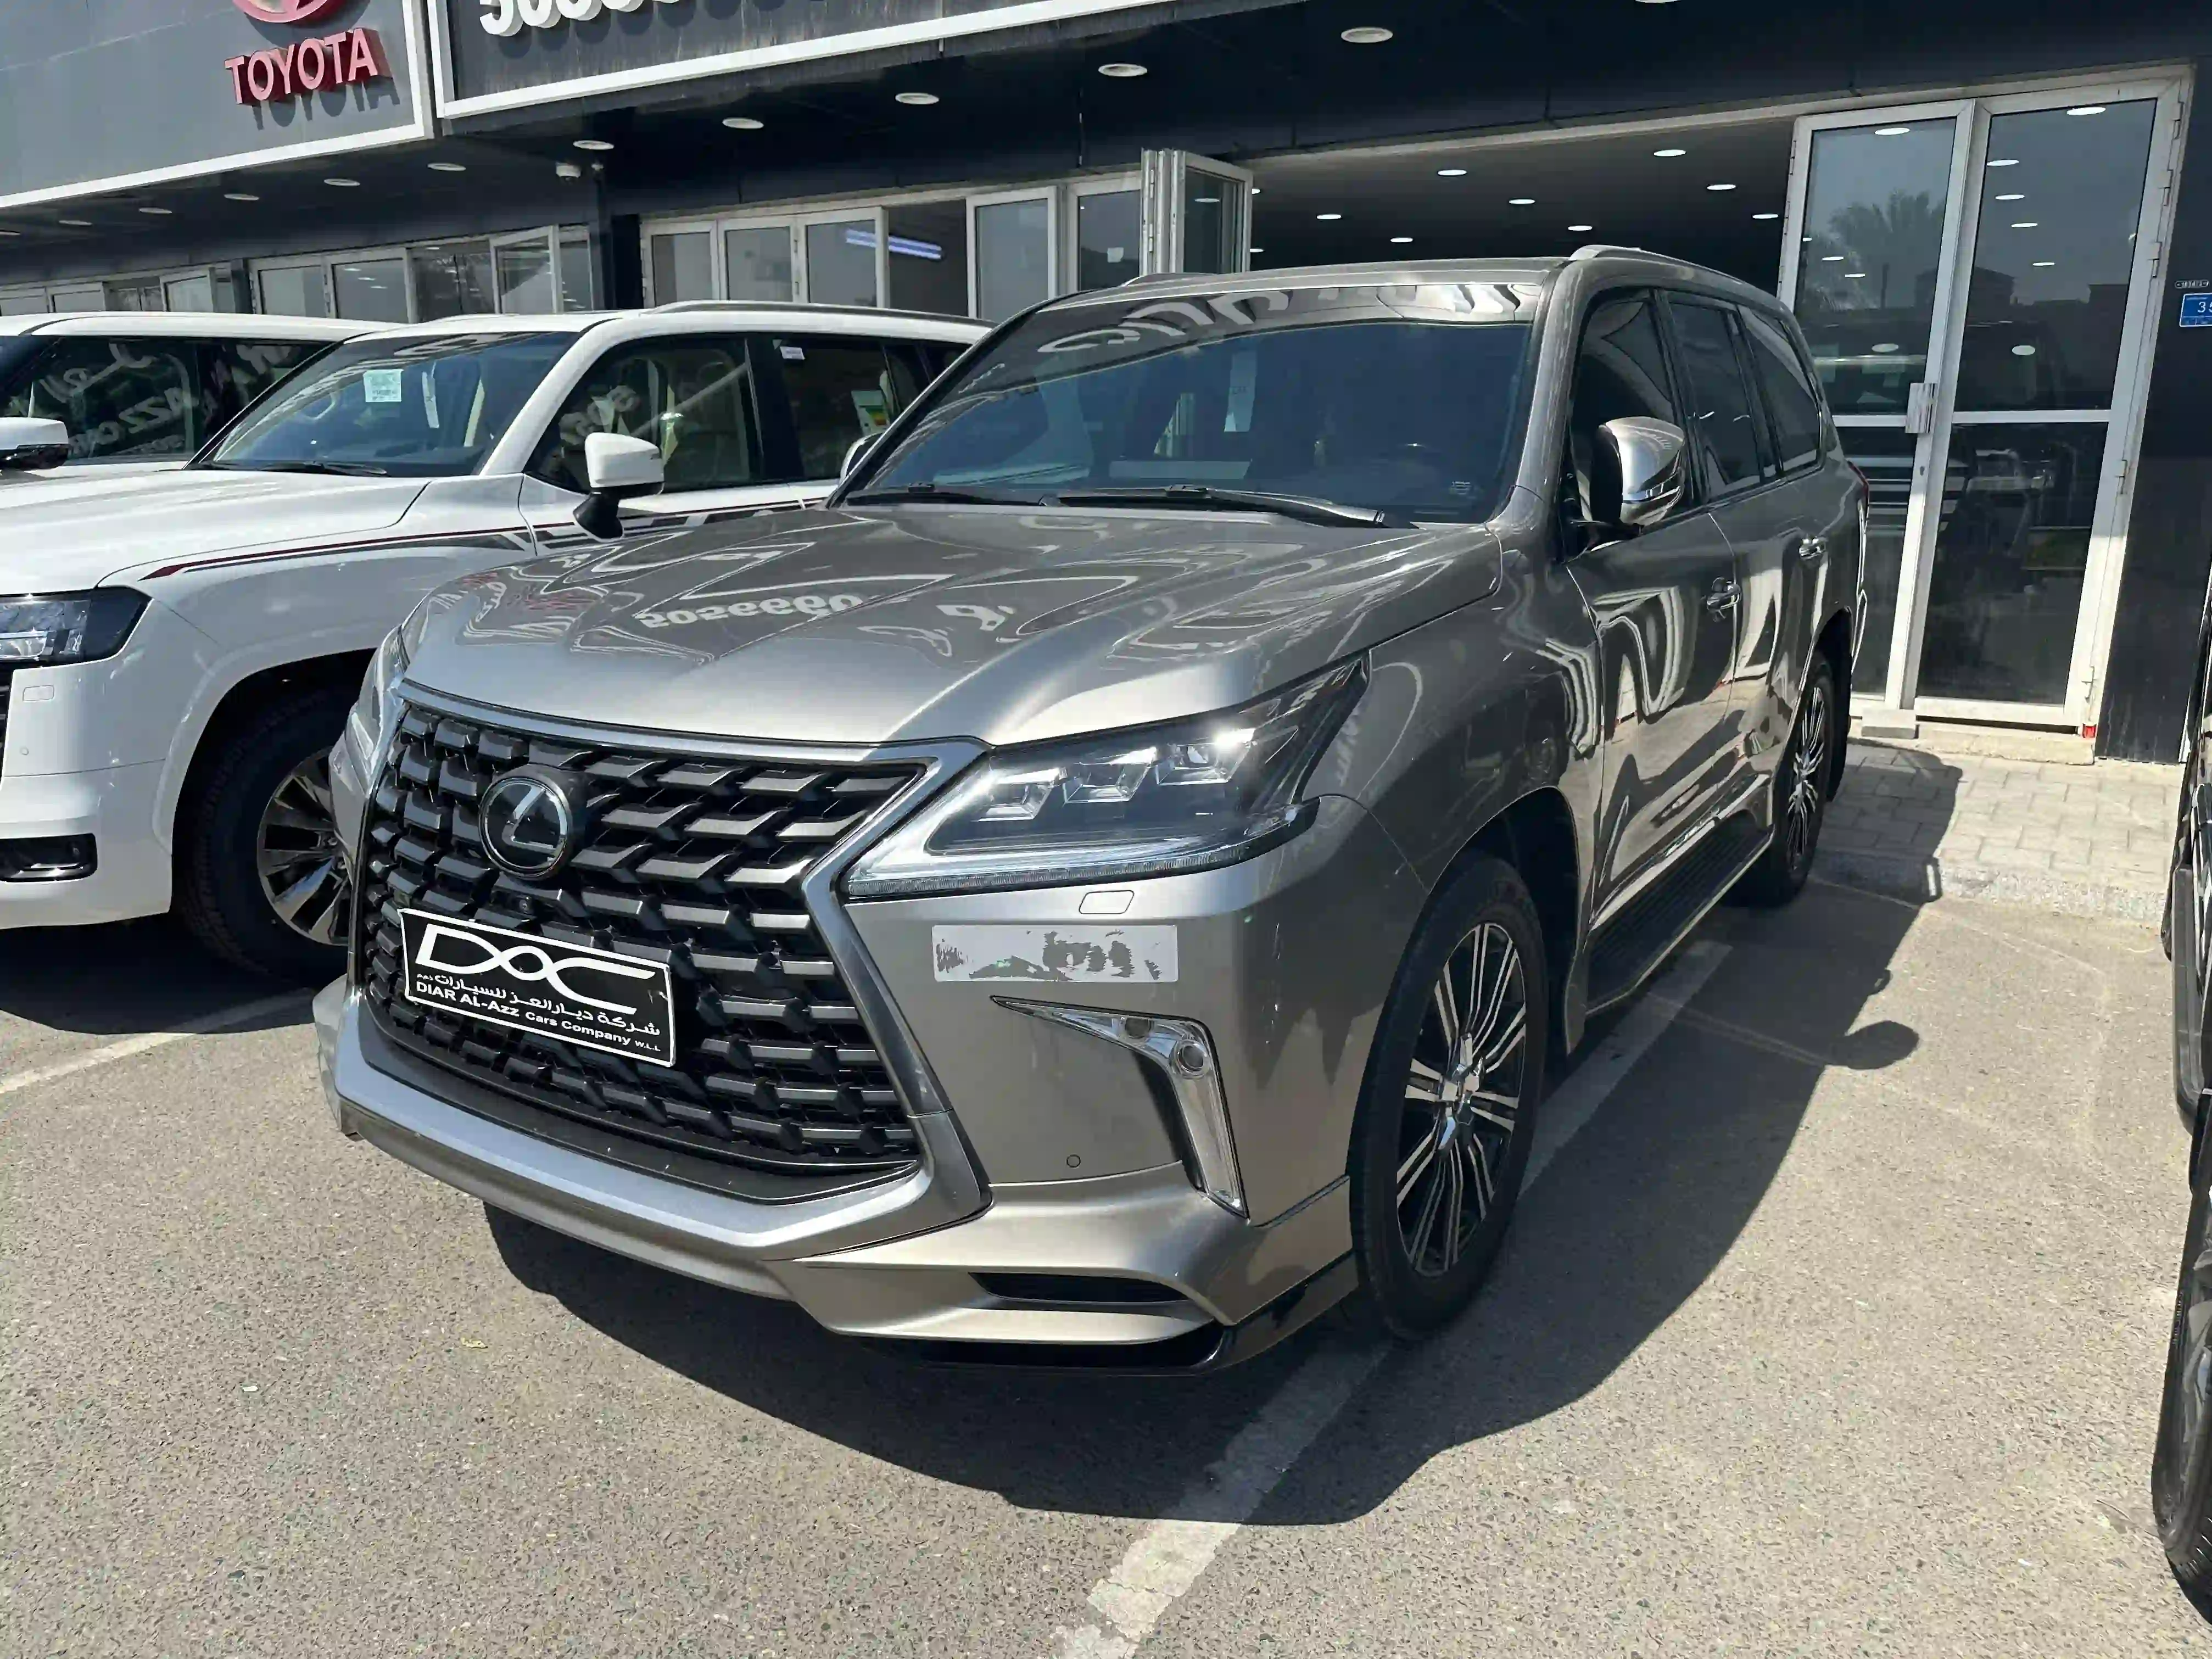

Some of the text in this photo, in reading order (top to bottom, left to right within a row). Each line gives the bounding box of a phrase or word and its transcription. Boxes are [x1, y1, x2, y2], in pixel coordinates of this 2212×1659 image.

[224, 28, 379, 104] TOYOTA
[434, 975, 507, 999] للسيارات
[509, 991, 552, 1010] العز
[551, 1003, 594, 1020] ديار
[416, 981, 457, 1001] DIAR
[524, 1012, 558, 1026] Cars
[561, 1020, 632, 1046] Company
[597, 1012, 660, 1036] شركة
